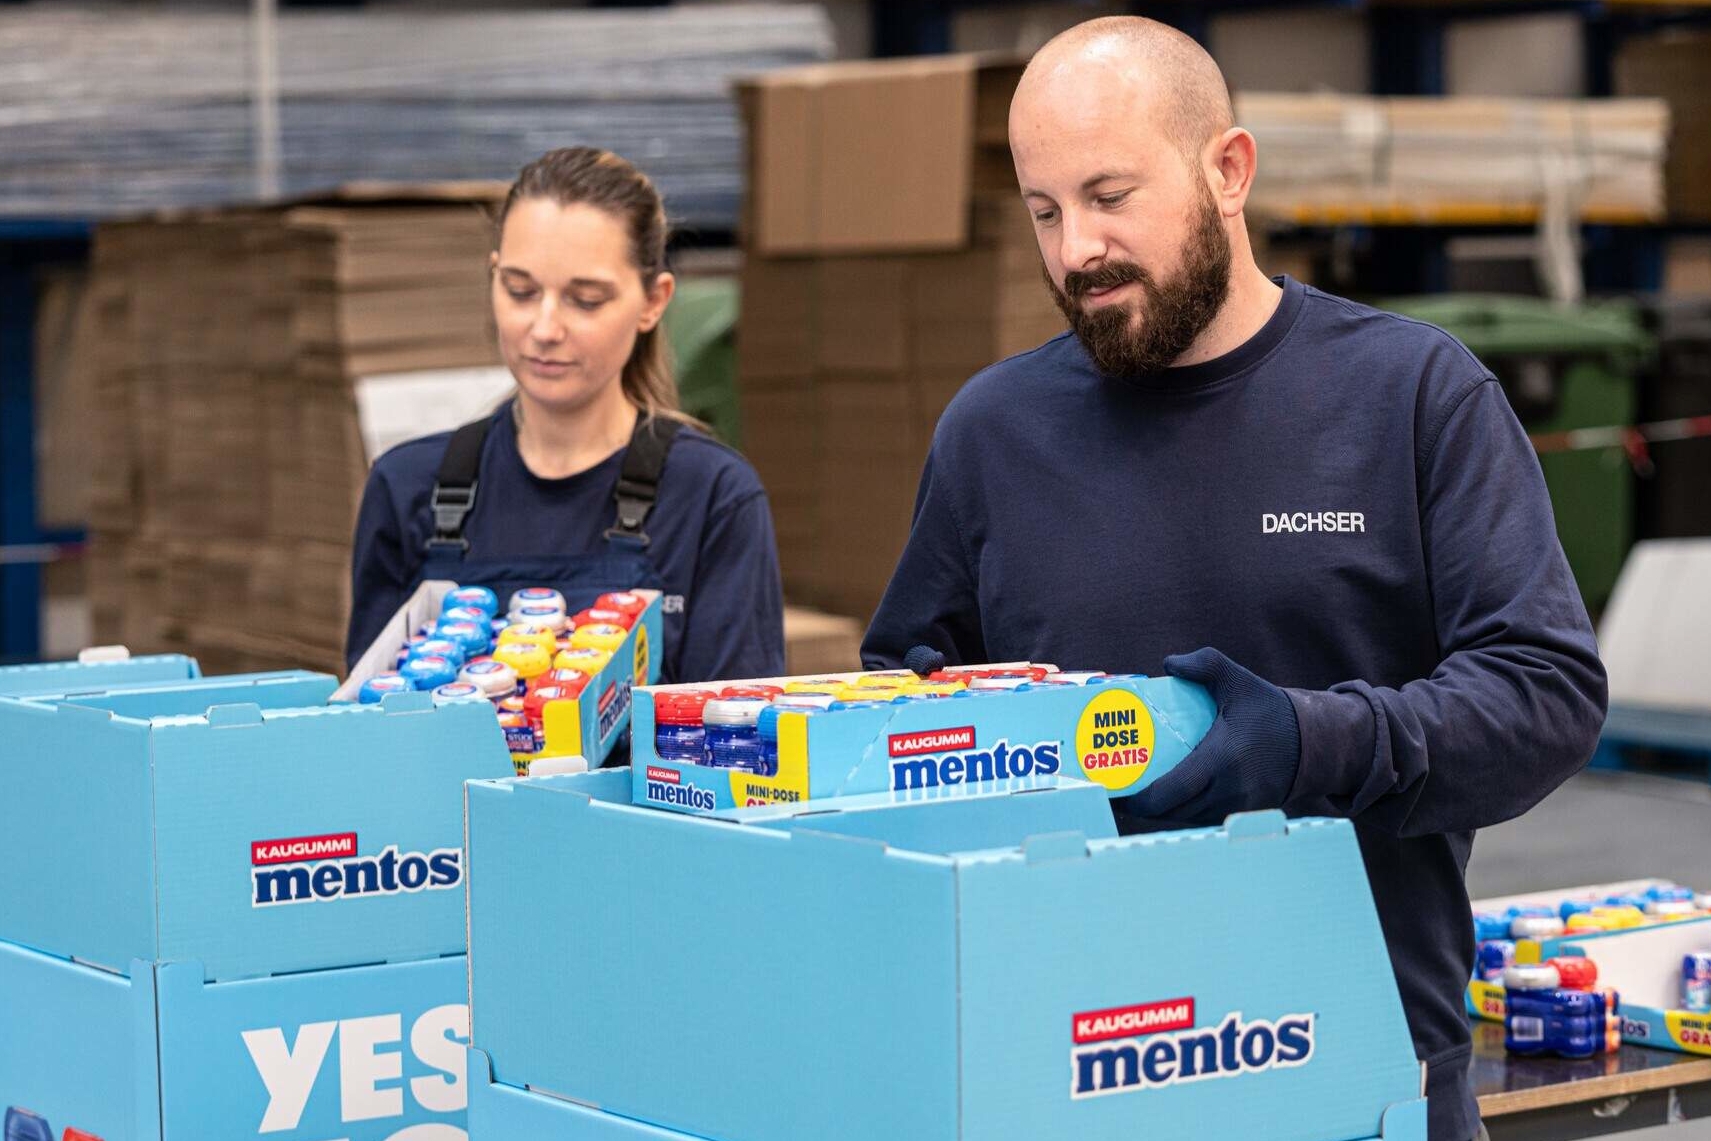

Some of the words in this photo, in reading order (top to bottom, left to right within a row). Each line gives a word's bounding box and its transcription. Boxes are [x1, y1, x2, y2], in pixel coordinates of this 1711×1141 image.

[1262, 511, 1365, 533] DACHSER
[1094, 709, 1136, 728] MINI
[892, 732, 971, 751] KAUGUMMI
[1093, 729, 1139, 749] DOSE
[893, 742, 1060, 790] mentos
[1084, 748, 1149, 770] GRATIS
[647, 782, 715, 811] mentos
[746, 783, 800, 803] MINI-DOSE
[256, 838, 351, 860] KAUGUMMI
[255, 850, 460, 903] mentos
[1077, 1004, 1189, 1036] KAUGUMMI
[1076, 1018, 1311, 1093] mentos
[240, 1003, 469, 1134] YES
